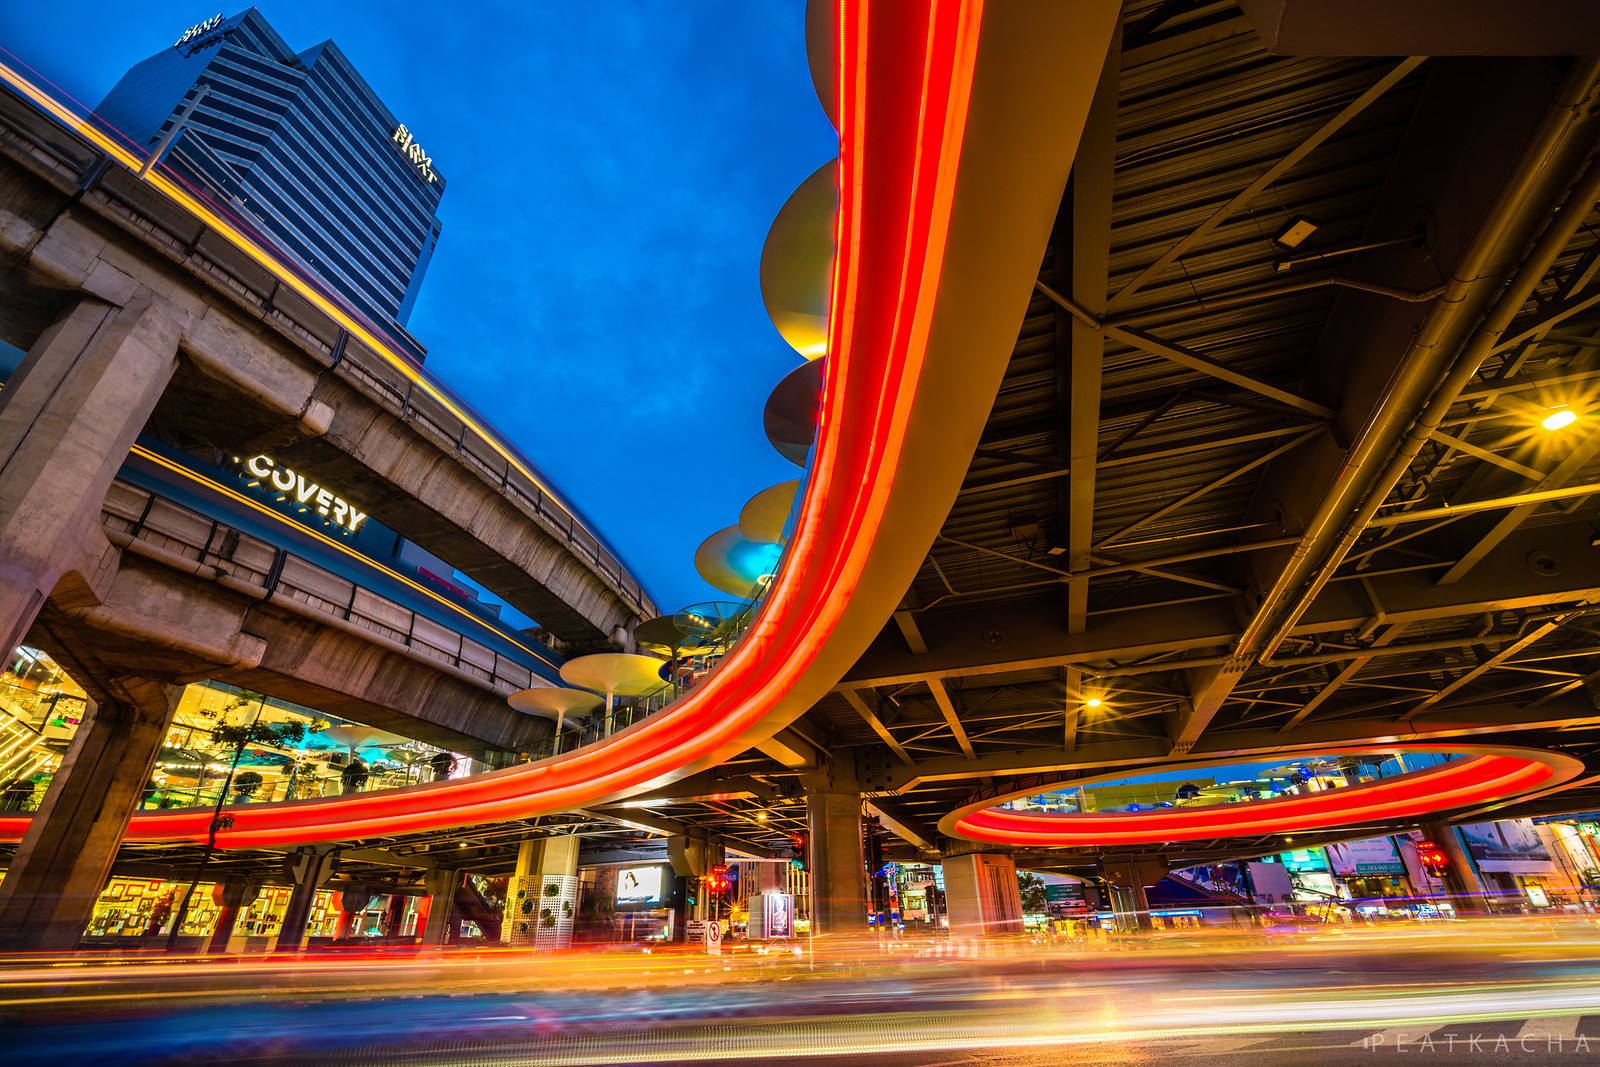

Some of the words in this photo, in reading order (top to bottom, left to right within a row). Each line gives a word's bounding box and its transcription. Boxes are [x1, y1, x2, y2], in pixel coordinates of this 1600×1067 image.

[393, 127, 438, 184] PIWAT
[399, 123, 433, 168] SIAM
[234, 454, 367, 531] COVERY
